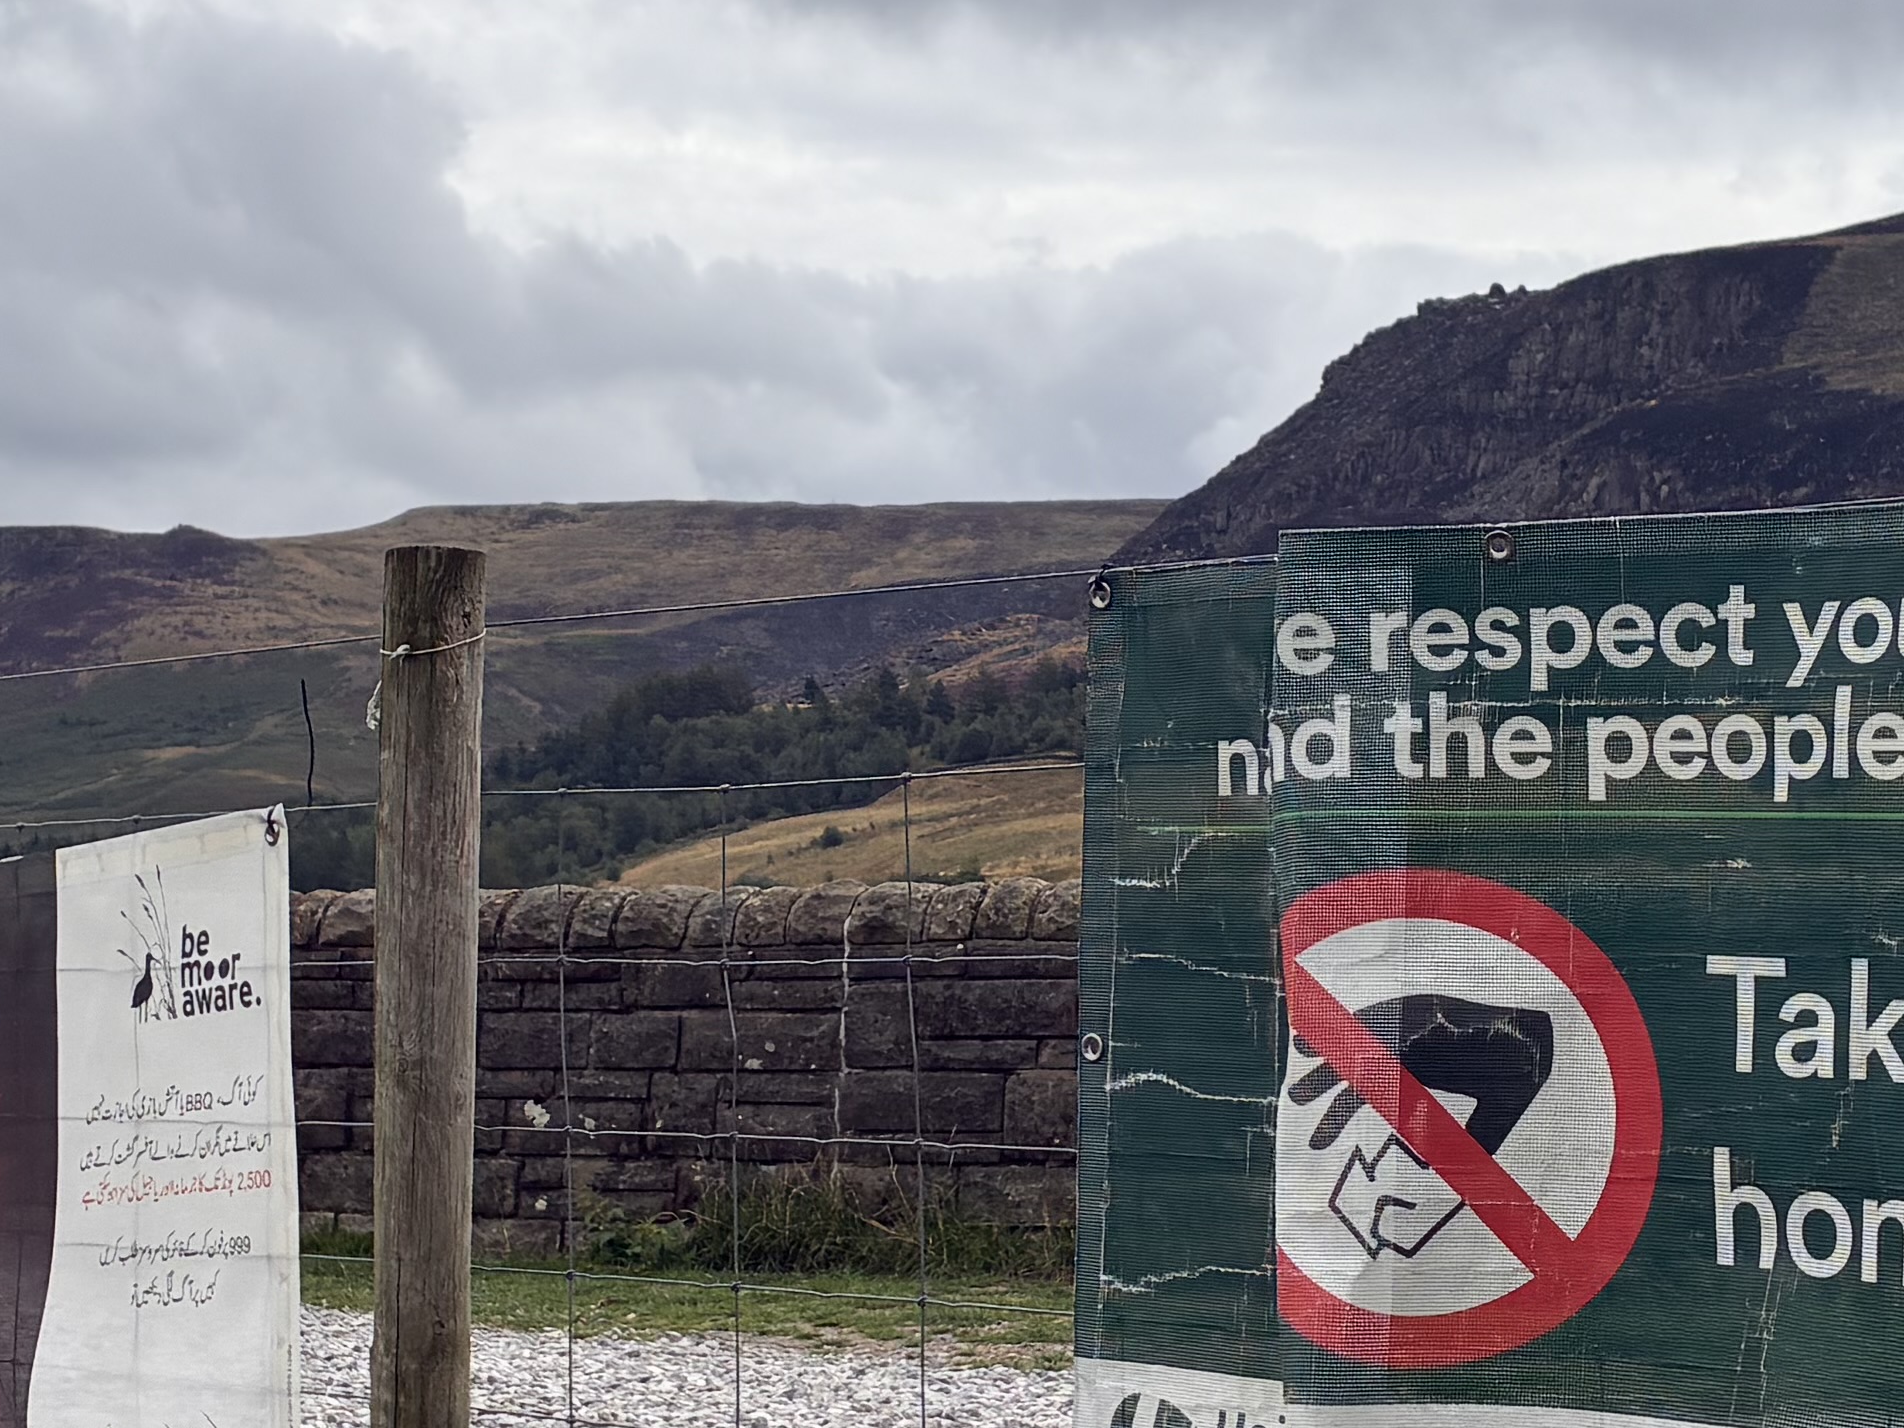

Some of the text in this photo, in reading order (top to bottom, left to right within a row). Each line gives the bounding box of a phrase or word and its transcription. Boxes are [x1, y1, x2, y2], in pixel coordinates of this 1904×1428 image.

[1367, 585, 1756, 692] respect
[1383, 691, 1553, 782] the
[181, 924, 210, 959] be
[181, 952, 241, 988] moor
[182, 981, 262, 1018] aware.
[186, 1091, 213, 1113] BBQ
[229, 1235, 252, 1255] 999
